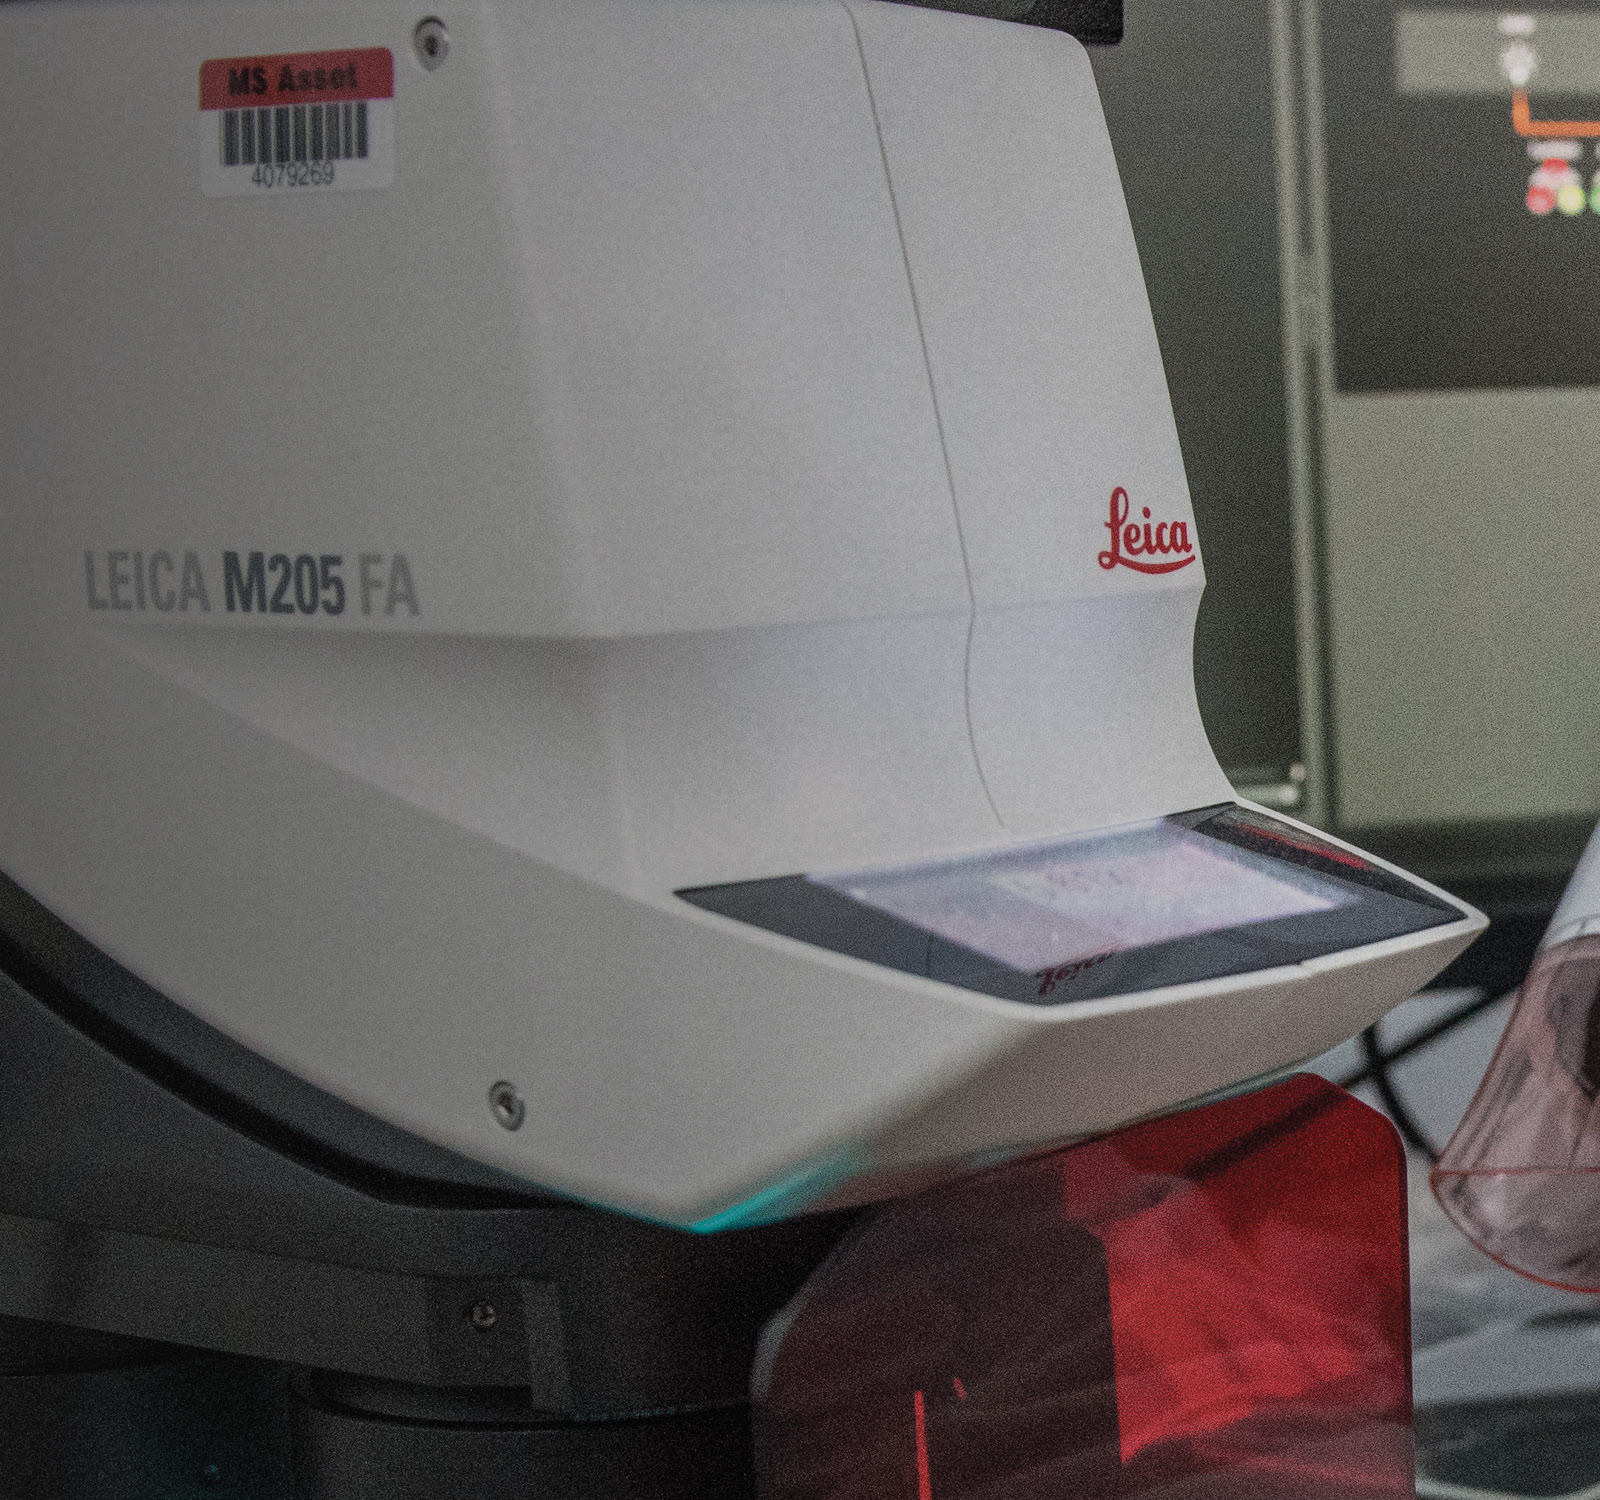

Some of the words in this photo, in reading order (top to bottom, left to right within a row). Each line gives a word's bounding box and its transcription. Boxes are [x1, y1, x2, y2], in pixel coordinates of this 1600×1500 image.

[227, 65, 269, 96] MS
[277, 61, 359, 93] Asset
[250, 161, 336, 189] 4079269
[1097, 486, 1196, 574] Leica
[85, 549, 212, 612] LEICA
[223, 550, 347, 616] M205
[357, 552, 422, 616] FA
